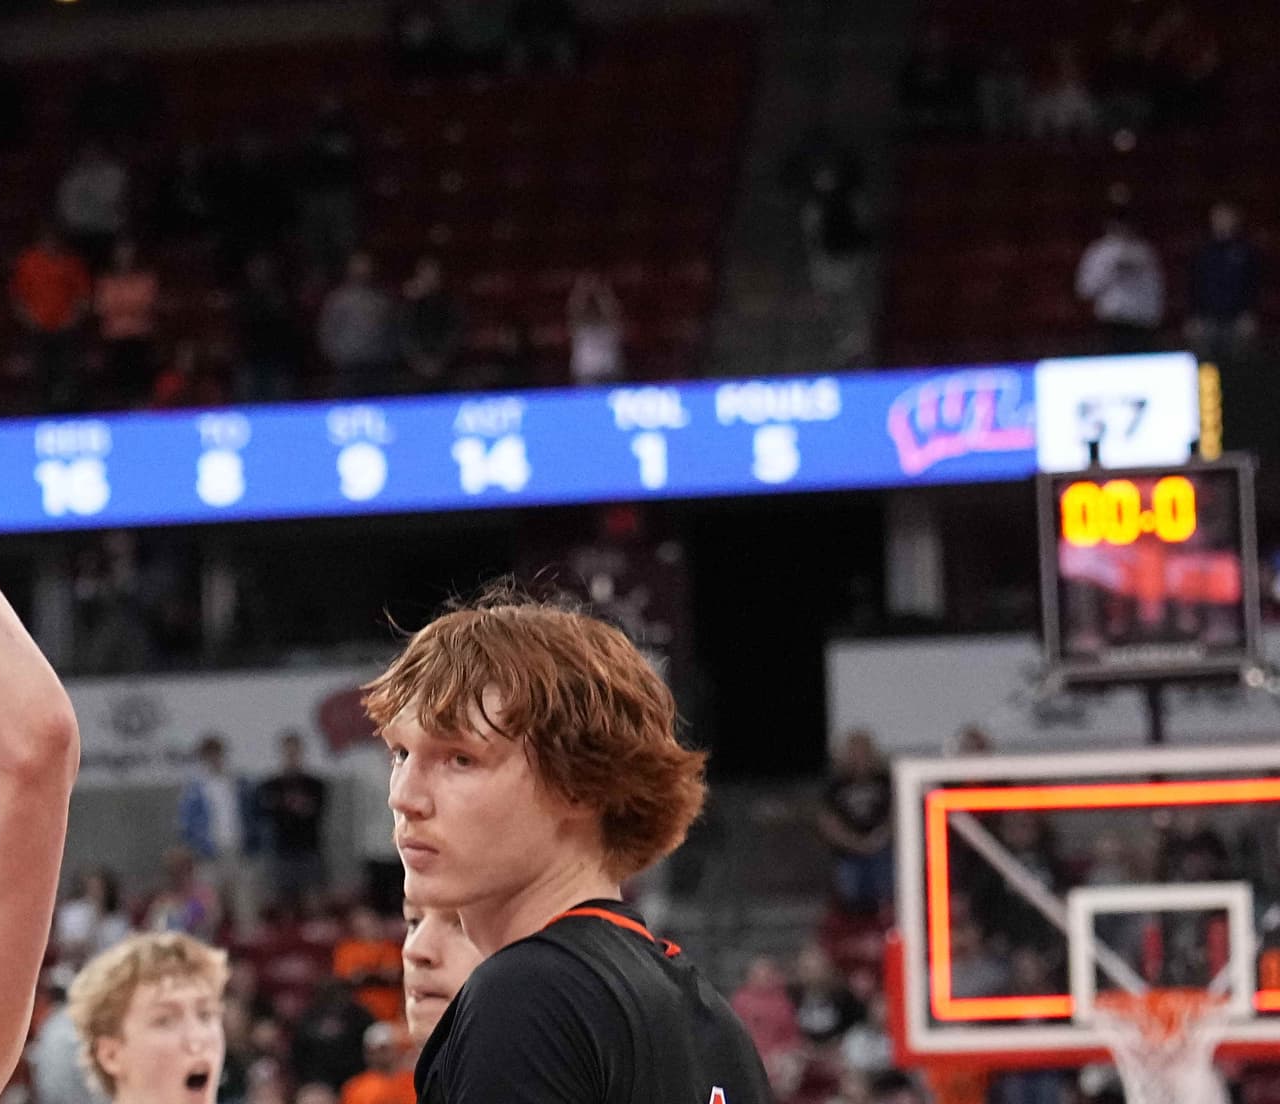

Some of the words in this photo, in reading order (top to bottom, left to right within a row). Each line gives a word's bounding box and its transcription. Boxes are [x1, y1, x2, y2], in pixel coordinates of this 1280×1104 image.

[716, 376, 840, 425] FOULS
[34, 457, 110, 515] 16
[336, 442, 387, 500] 9
[451, 434, 531, 495] 14
[631, 431, 668, 490] 1
